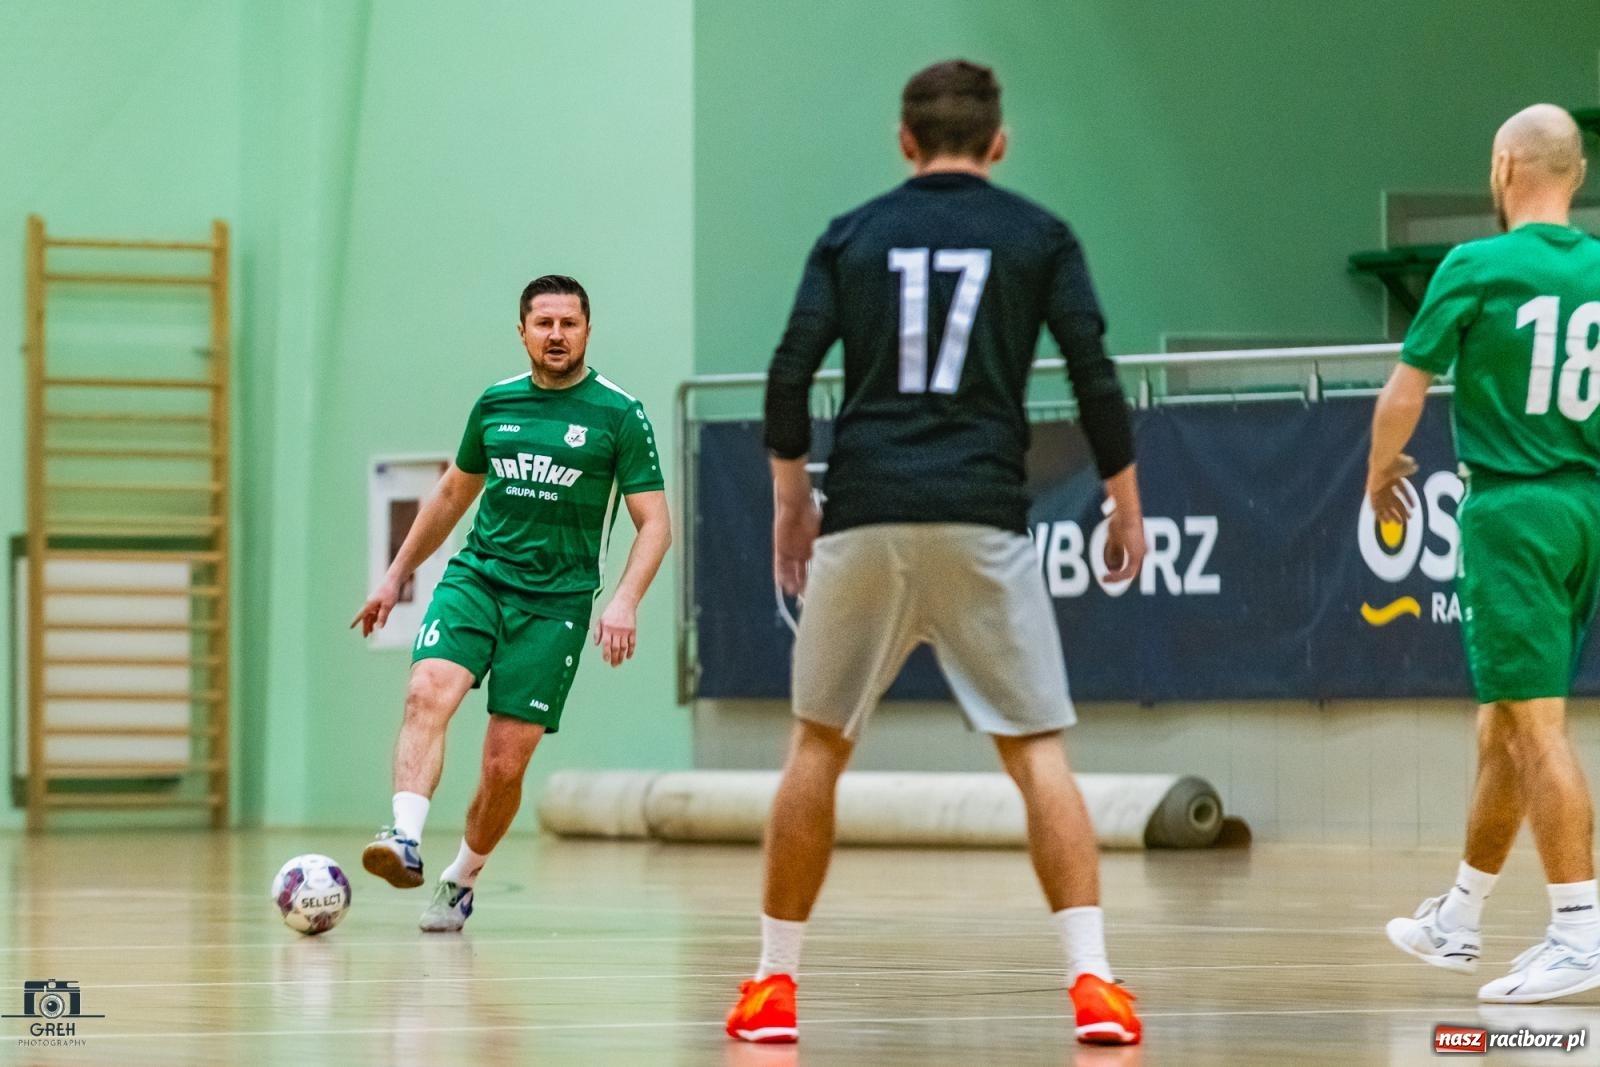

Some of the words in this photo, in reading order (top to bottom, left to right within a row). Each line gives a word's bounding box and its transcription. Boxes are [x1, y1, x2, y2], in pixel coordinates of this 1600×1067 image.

[888, 247, 992, 394] 17
[1515, 295, 1600, 422] 18
[498, 424, 520, 432] JAKO
[506, 486, 535, 498] GRUPA
[538, 490, 558, 501] PBG
[416, 619, 440, 650] 16
[529, 699, 549, 712] JAKO
[301, 893, 340, 908] SELECT
